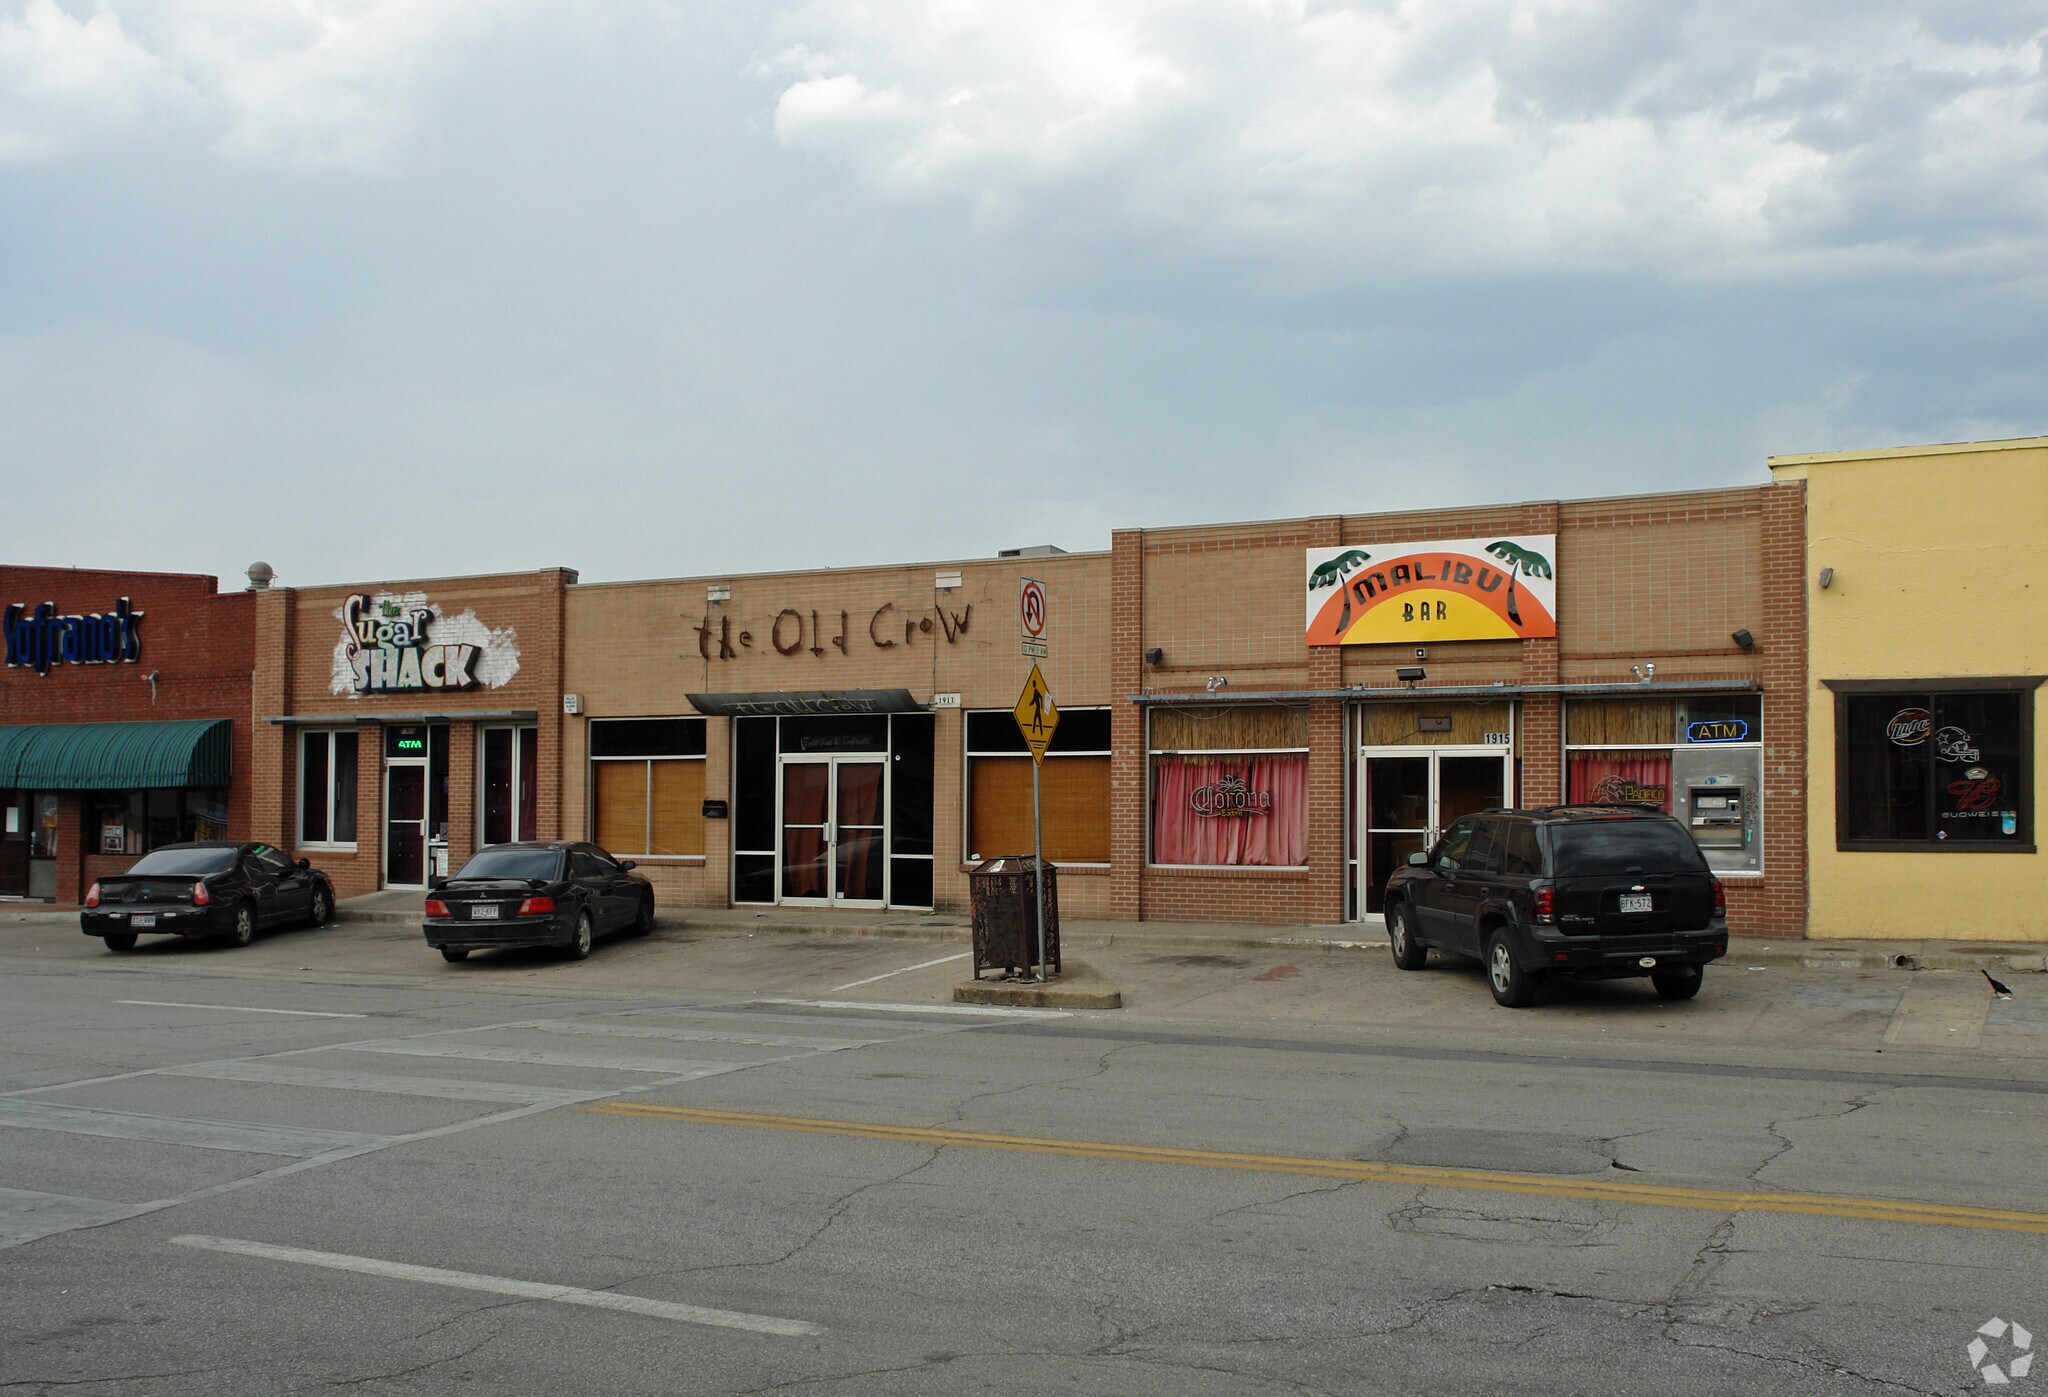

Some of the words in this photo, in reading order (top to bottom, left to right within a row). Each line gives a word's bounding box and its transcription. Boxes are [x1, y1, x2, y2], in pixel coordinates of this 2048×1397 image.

[1352, 560, 1503, 605] MALIBU
[1402, 600, 1447, 622] BAR
[343, 593, 431, 660] Sugar
[772, 609, 848, 657] Old
[351, 643, 480, 691] SHACK
[398, 740, 422, 748] ATM
[1486, 733, 1510, 744] 1915
[1698, 723, 1737, 738] ATM
[1190, 786, 1271, 814] Corona
